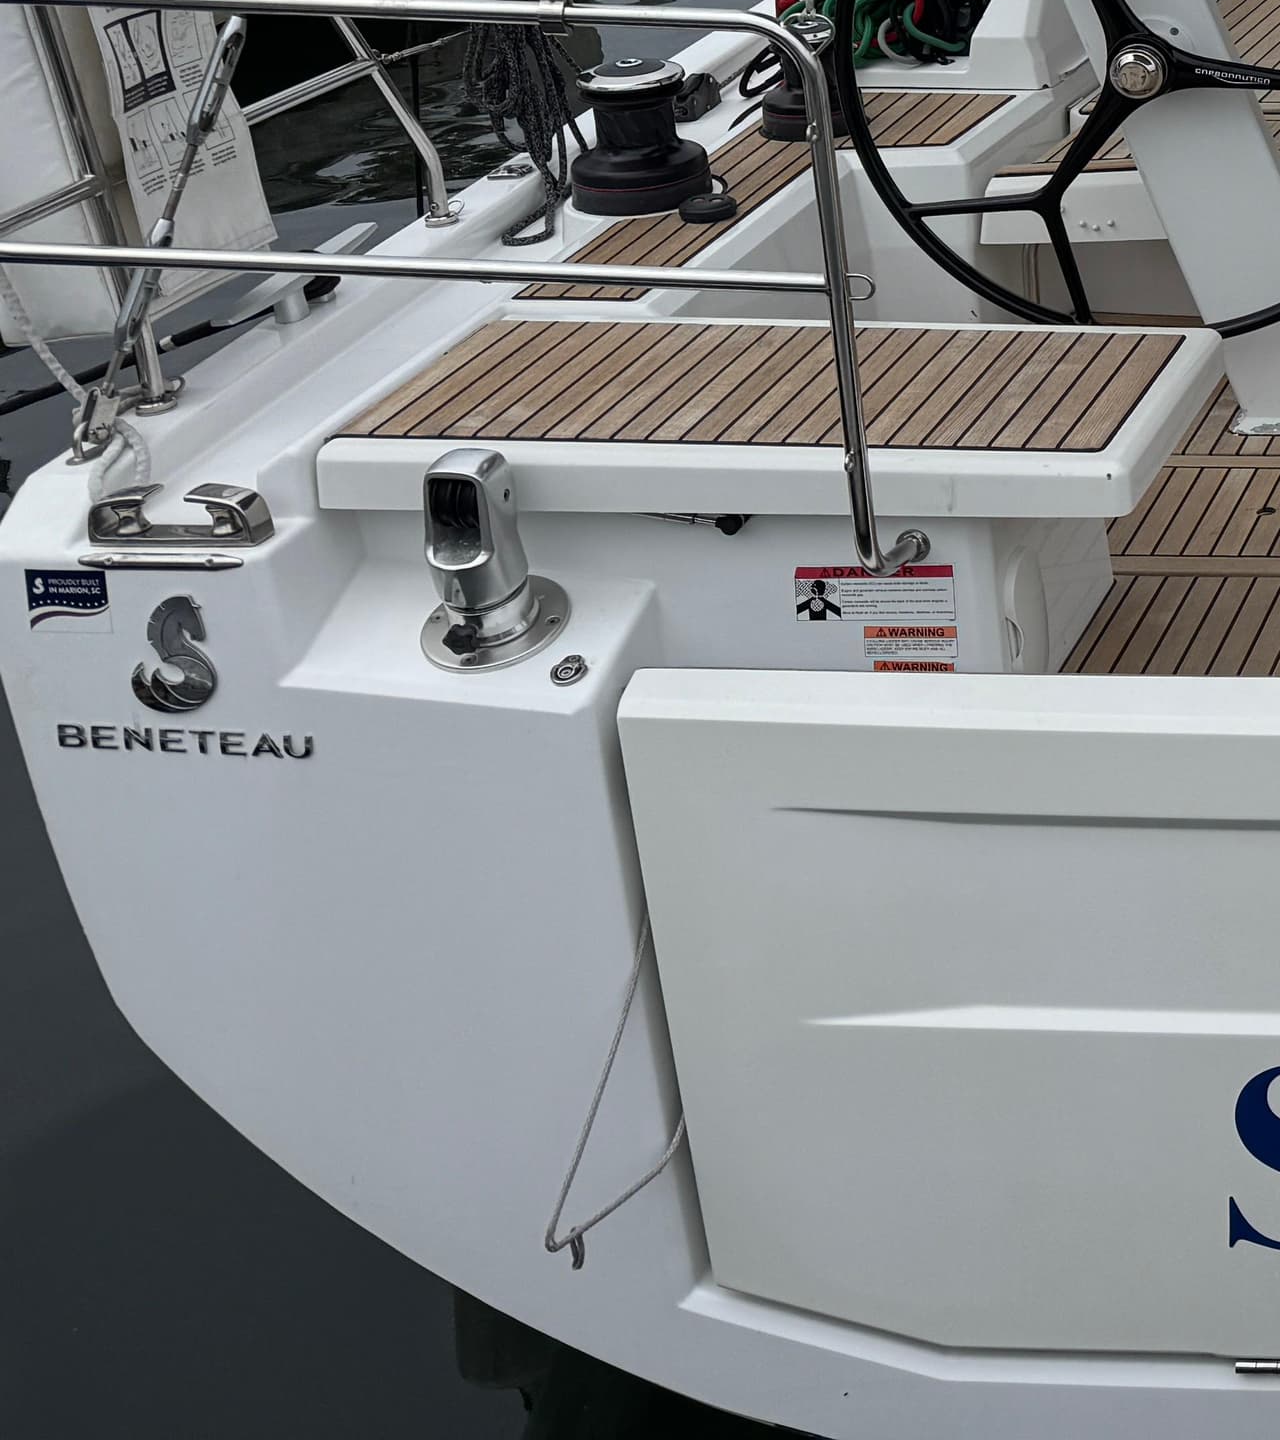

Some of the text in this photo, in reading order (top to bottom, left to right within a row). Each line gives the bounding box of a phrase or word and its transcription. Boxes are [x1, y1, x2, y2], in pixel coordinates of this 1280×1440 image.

[832, 566, 915, 578] DAER
[47, 578, 80, 587] PROUDLY
[48, 586, 57, 594] IN
[91, 586, 101, 595] SC
[887, 626, 945, 638] WARNING
[892, 662, 948, 672] WARNING
[57, 723, 314, 760] BENETEAU
